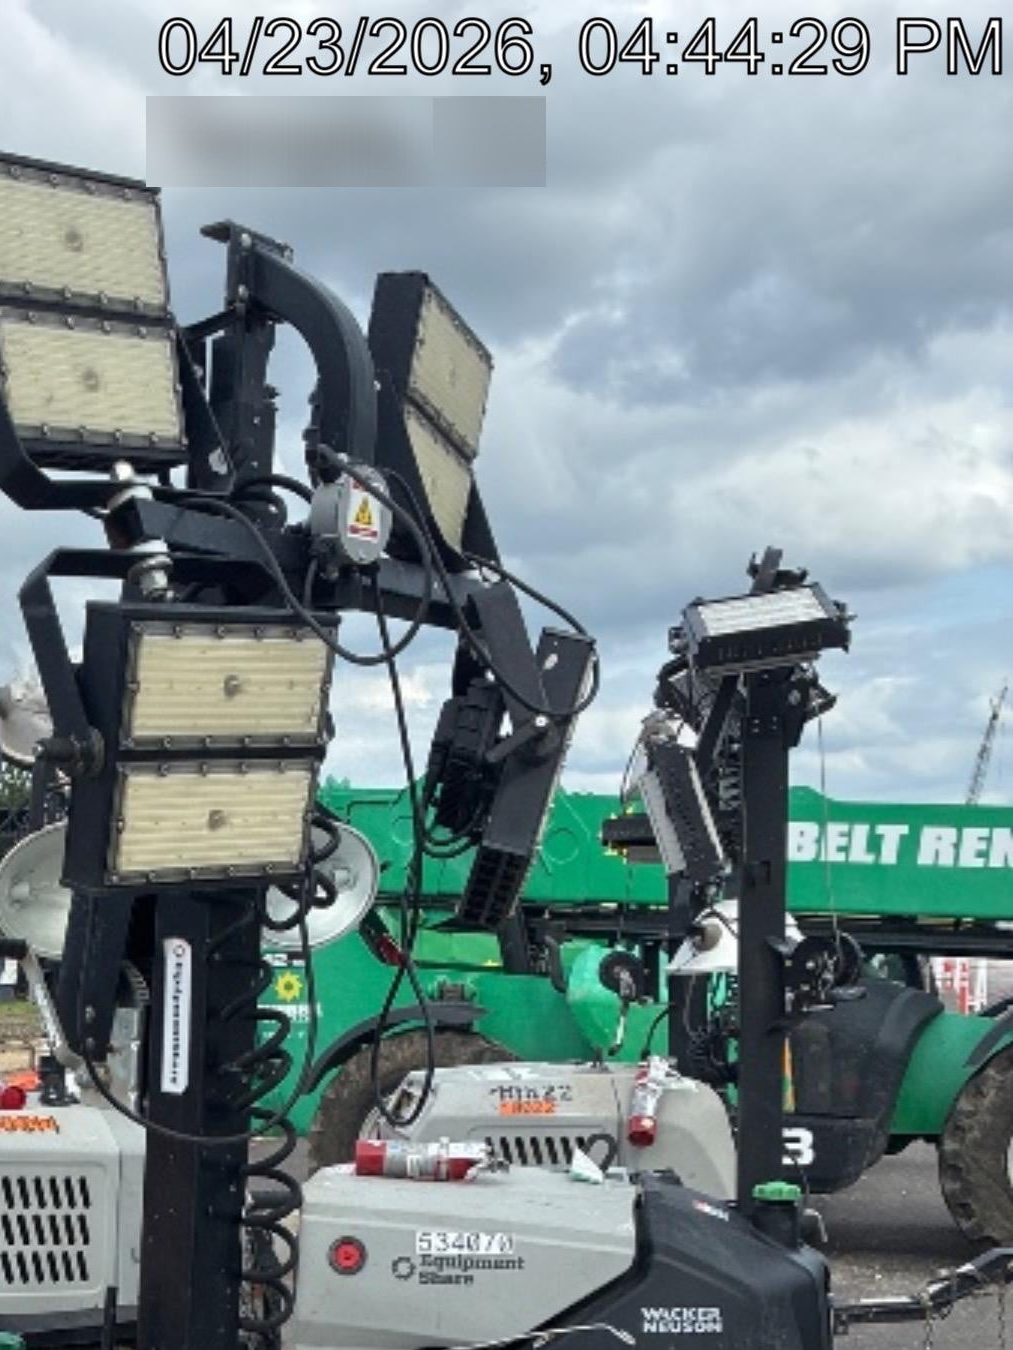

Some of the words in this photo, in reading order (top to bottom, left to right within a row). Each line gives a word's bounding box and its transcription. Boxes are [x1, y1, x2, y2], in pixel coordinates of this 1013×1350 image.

[787, 821, 910, 865] BELT
[419, 1253, 525, 1273] Equipment
[641, 1307, 721, 1321] WACKER
[643, 1319, 723, 1334] NEUSON
